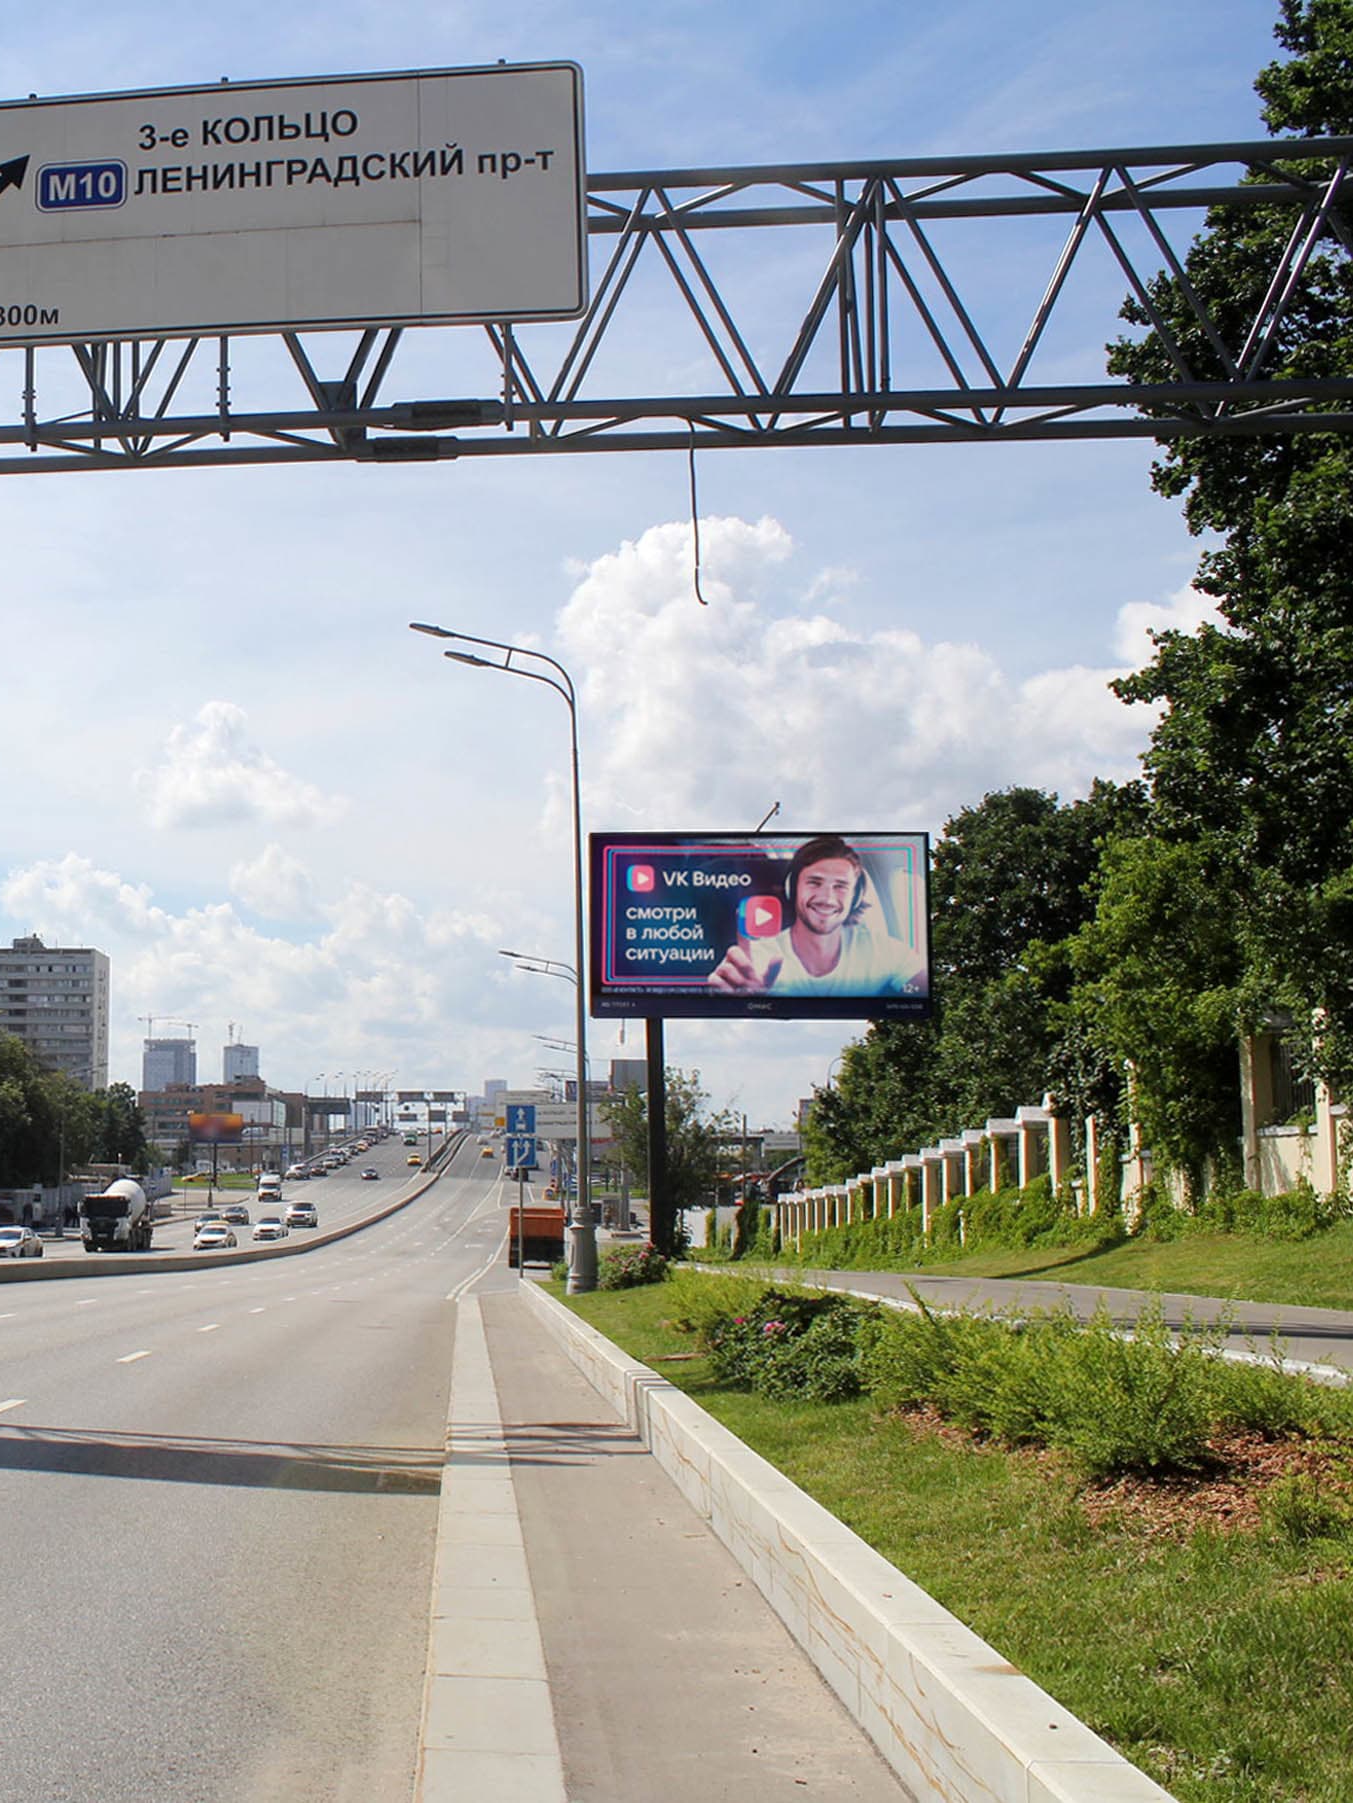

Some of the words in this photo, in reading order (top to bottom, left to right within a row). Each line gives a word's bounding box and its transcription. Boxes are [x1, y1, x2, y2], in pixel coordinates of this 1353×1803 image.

[139, 123, 189, 150] 3-е
[203, 110, 359, 146] КОЛЬЦО
[134, 144, 463, 196] ЛЕНИНГРАДСКИЙ
[478, 151, 554, 179] пр-т
[49, 169, 117, 202] М10
[662, 871, 688, 886] VK
[693, 871, 752, 888] Видео
[625, 907, 697, 922] смотри
[626, 929, 636, 940] в
[641, 924, 704, 941] любой
[625, 948, 714, 964] ситуации
